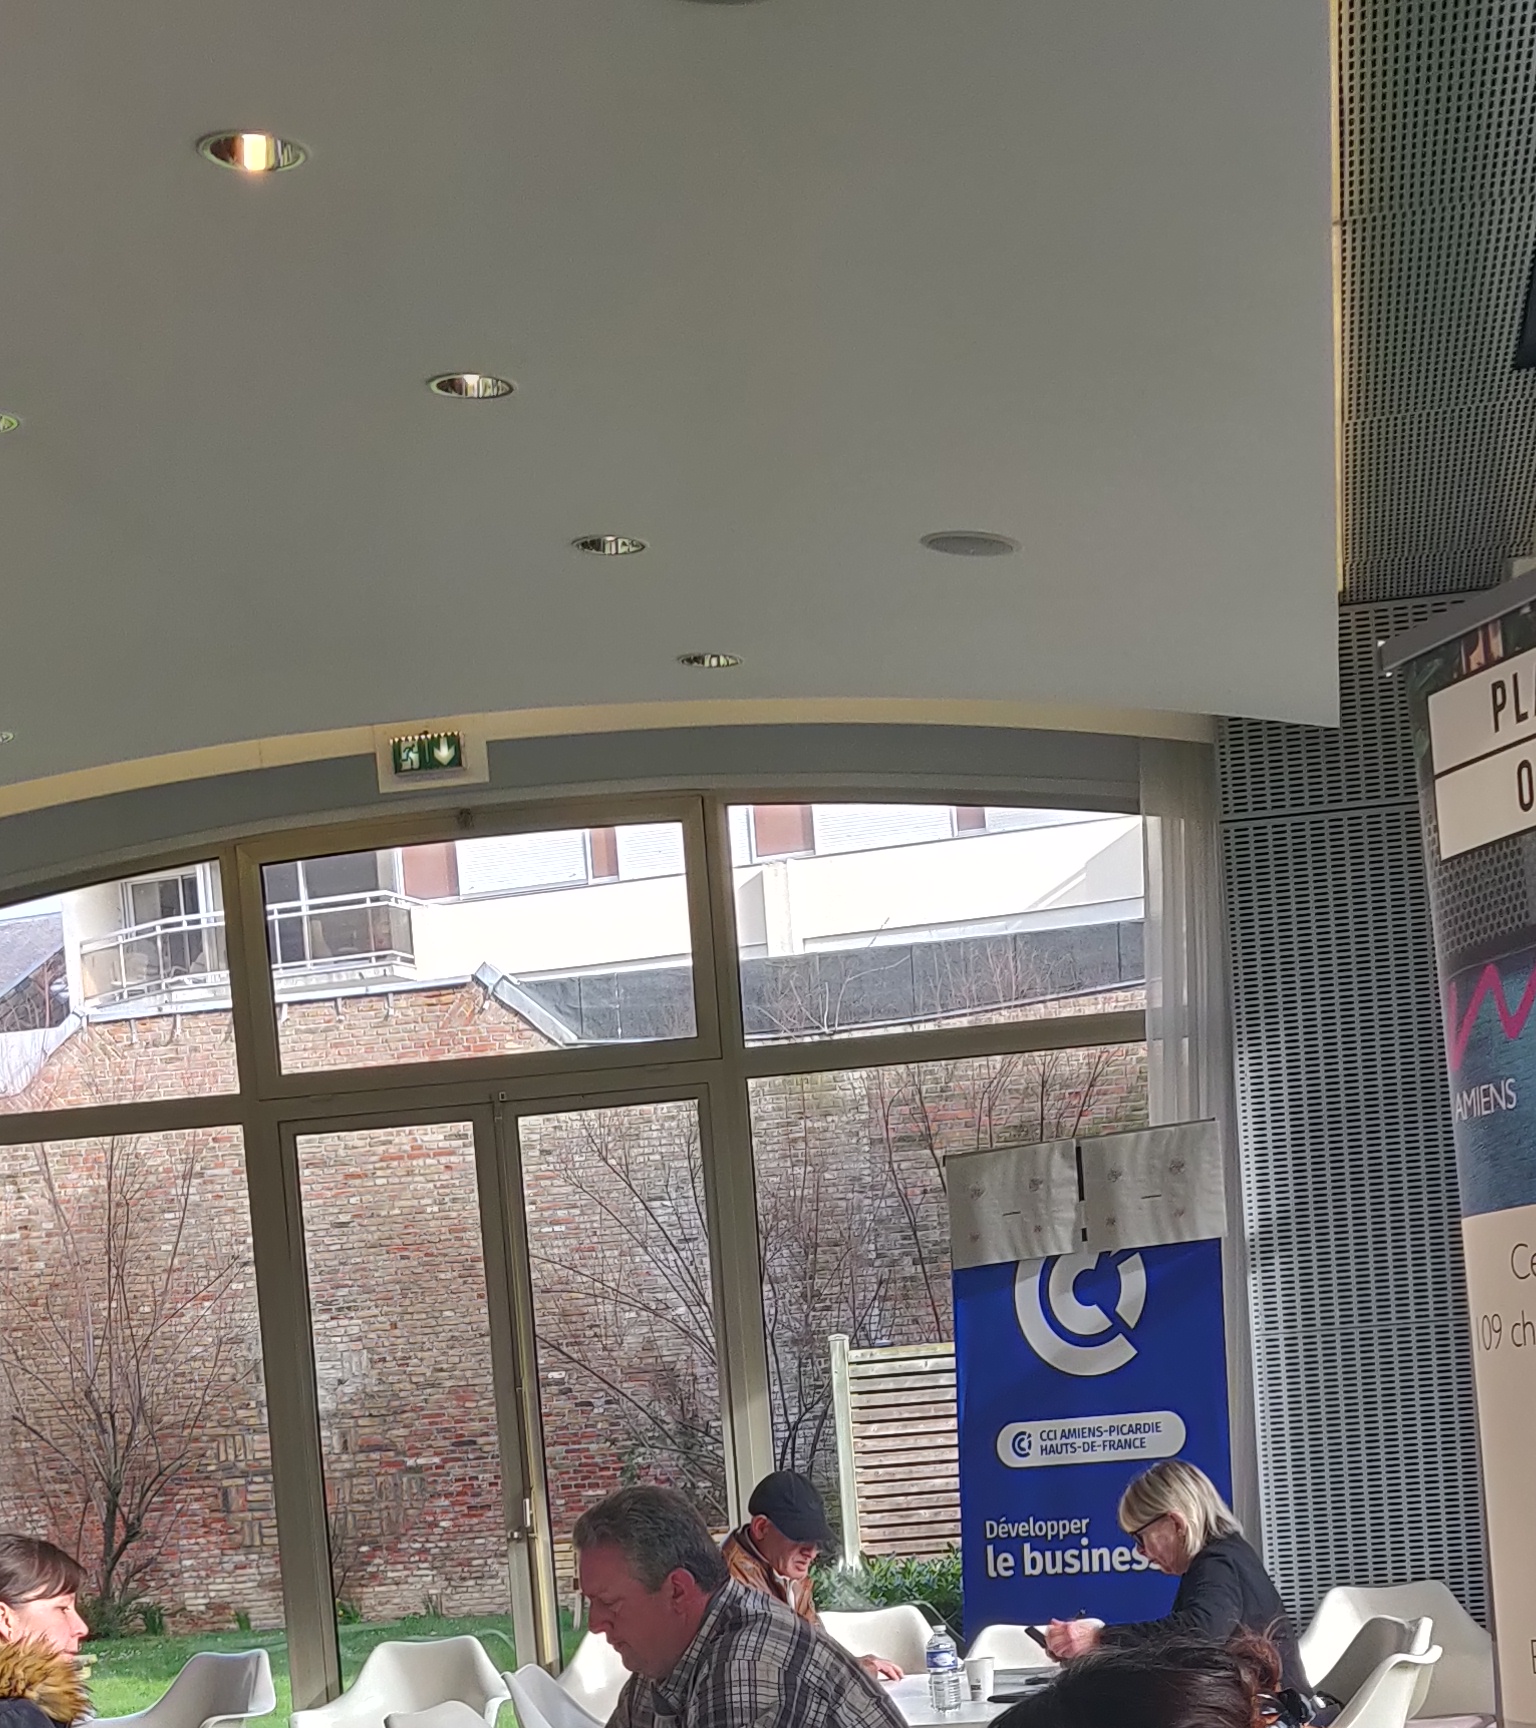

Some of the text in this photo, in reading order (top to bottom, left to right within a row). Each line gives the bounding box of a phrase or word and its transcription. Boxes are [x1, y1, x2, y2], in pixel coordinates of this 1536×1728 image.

[1455, 1078, 1517, 1123] AMIENS
[1039, 1421, 1162, 1441] CCI AMIENS-PICARDIE
[1040, 1437, 1147, 1456] HAUTS-DE-FRANCE
[985, 1516, 1090, 1541] Développer
[987, 1544, 1015, 1578] le
